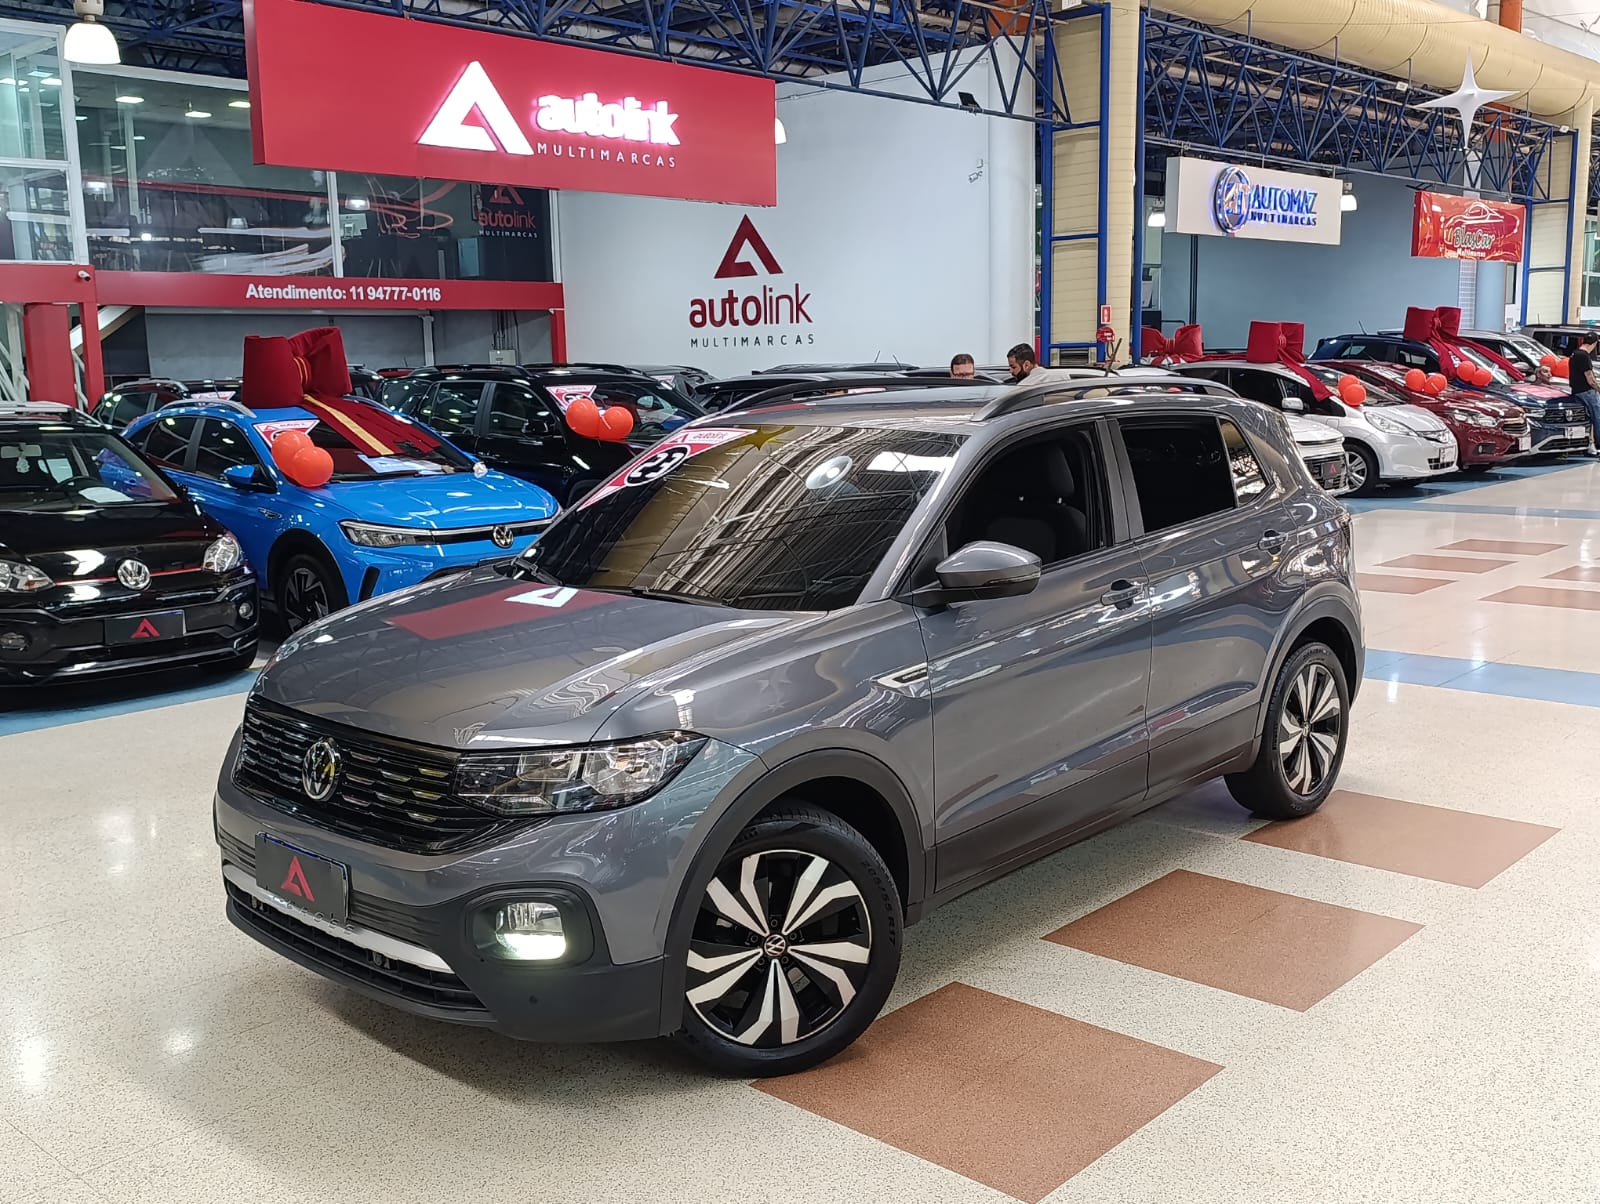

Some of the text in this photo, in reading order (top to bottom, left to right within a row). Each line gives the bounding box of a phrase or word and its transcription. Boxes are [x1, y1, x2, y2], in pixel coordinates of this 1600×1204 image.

[537, 92, 681, 146] autolink
[537, 142, 676, 168] MULTIMARCAS
[1251, 184, 1318, 214] AUTOMAZ
[479, 209, 537, 229] autolink
[1251, 211, 1317, 226] MULTIMARCAS
[479, 229, 538, 239] MULTIMARCAS
[245, 283, 441, 301] Atendimento: 11 94777-0116
[689, 282, 813, 329] autolink
[690, 333, 815, 349] MULTIMARCAS
[629, 452, 684, 478] 23
